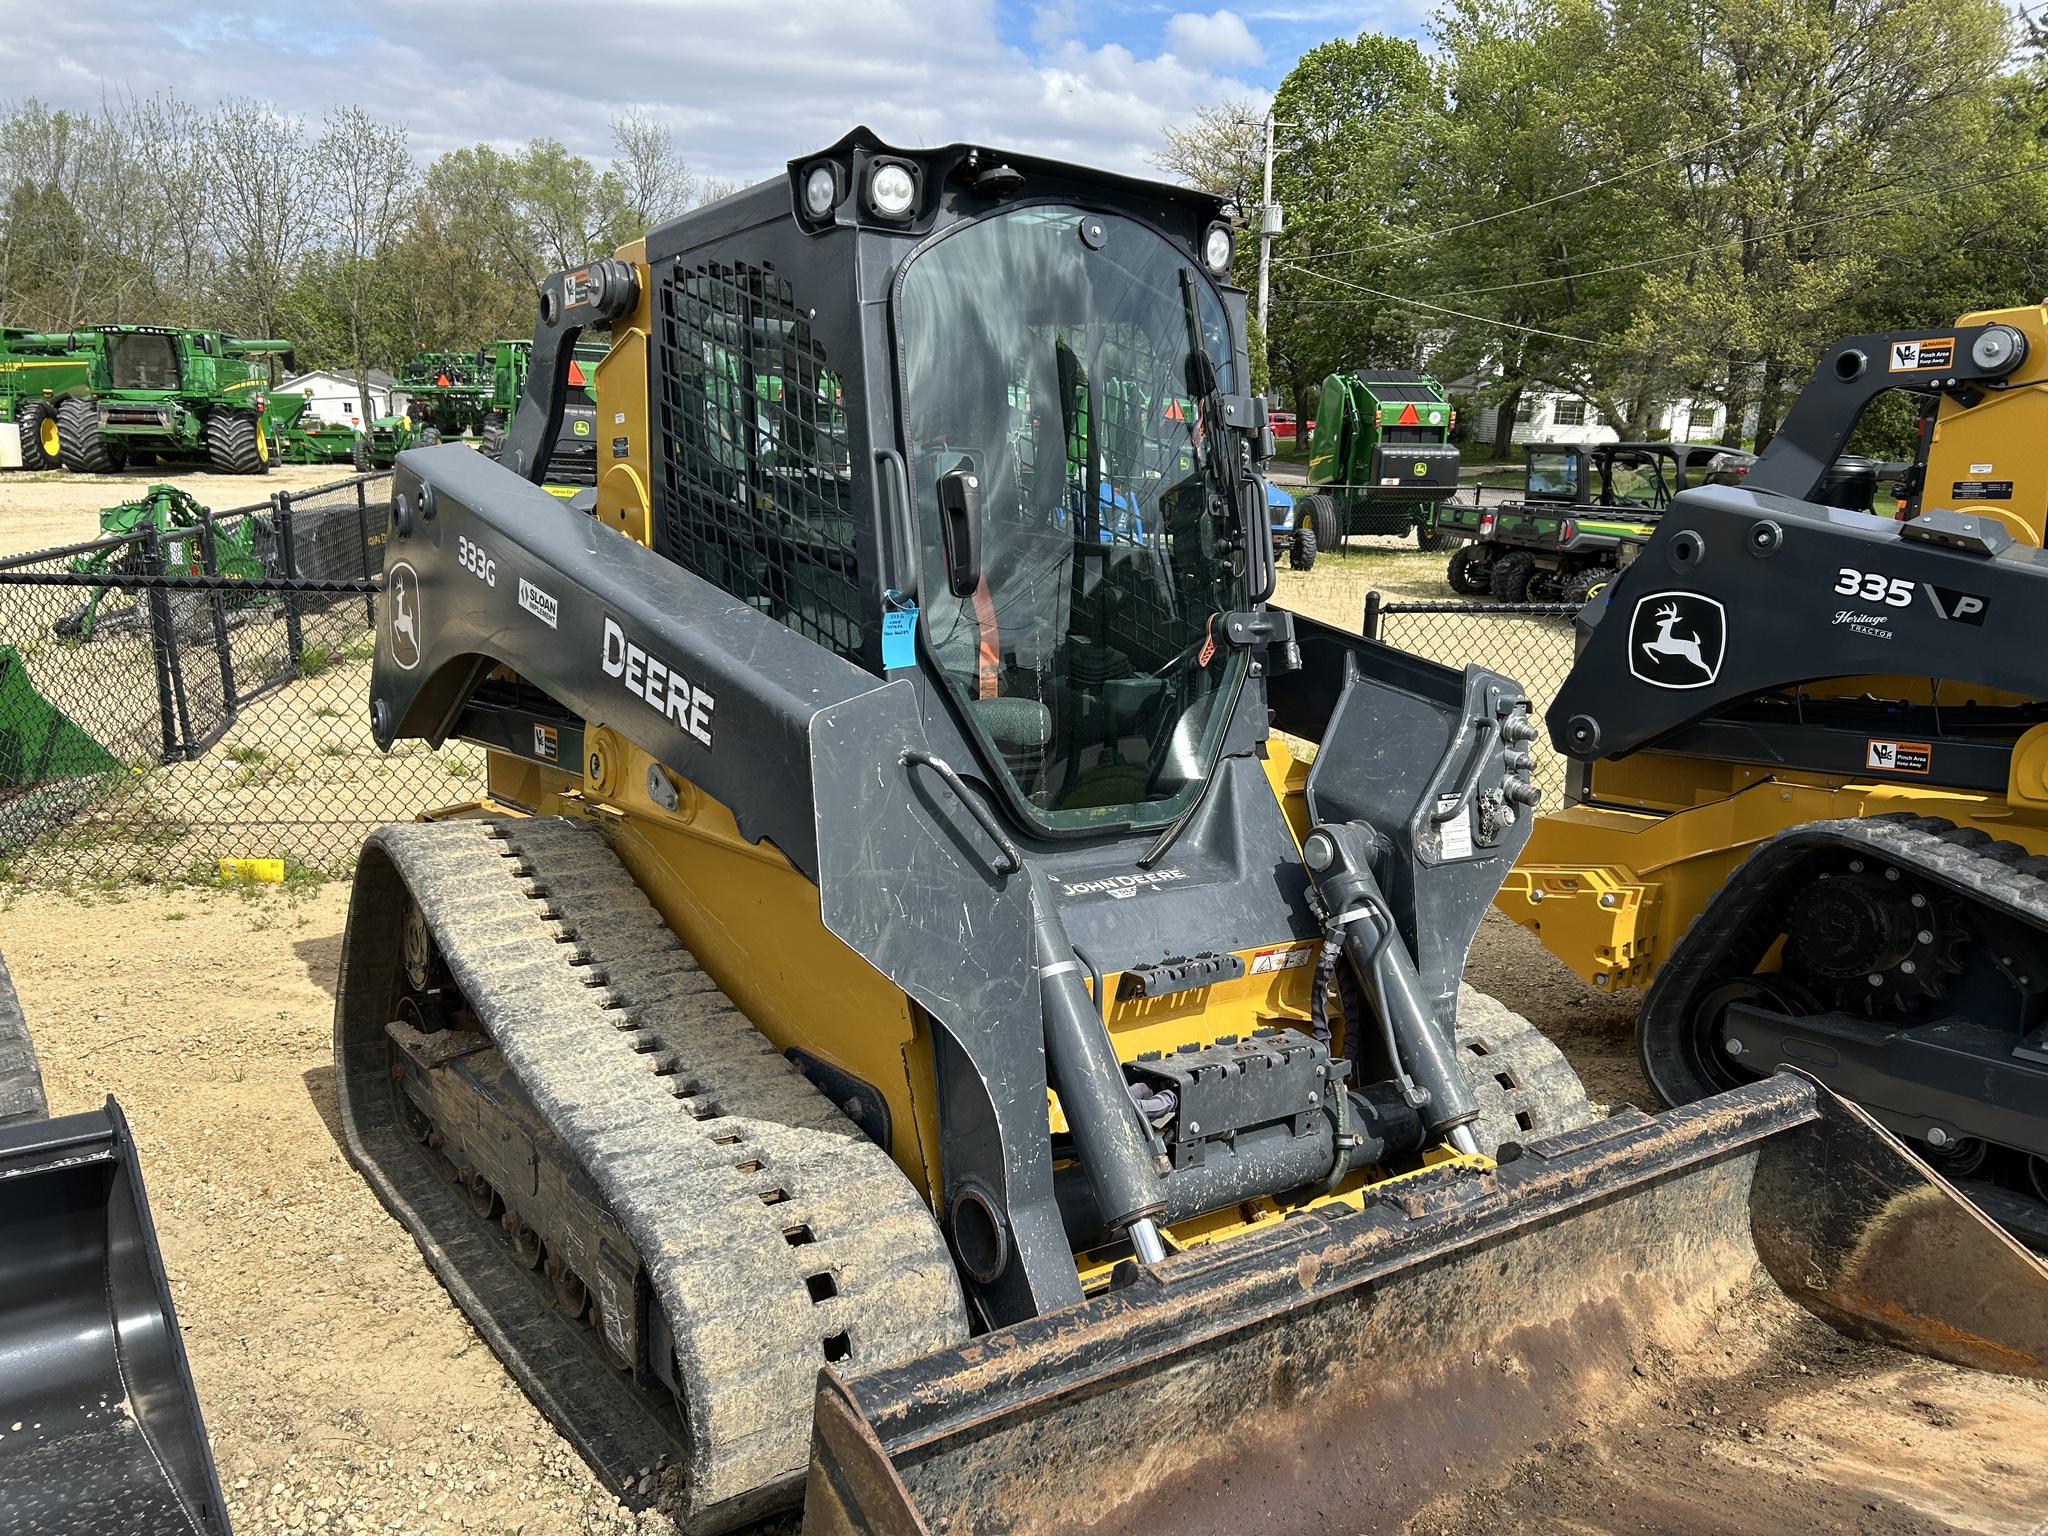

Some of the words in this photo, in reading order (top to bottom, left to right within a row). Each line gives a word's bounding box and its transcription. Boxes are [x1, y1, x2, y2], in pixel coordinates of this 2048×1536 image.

[458, 535, 496, 588] 333G
[529, 588, 556, 615] SLOAN
[1834, 568, 1916, 608] 335
[528, 602, 556, 624] IMPLEMENT
[1832, 610, 1888, 626] Heritage
[1849, 624, 1893, 639] TRACTOR
[602, 617, 715, 747] DEERE
[1062, 880, 1117, 896] JOHN
[1115, 869, 1187, 887] DEERE
